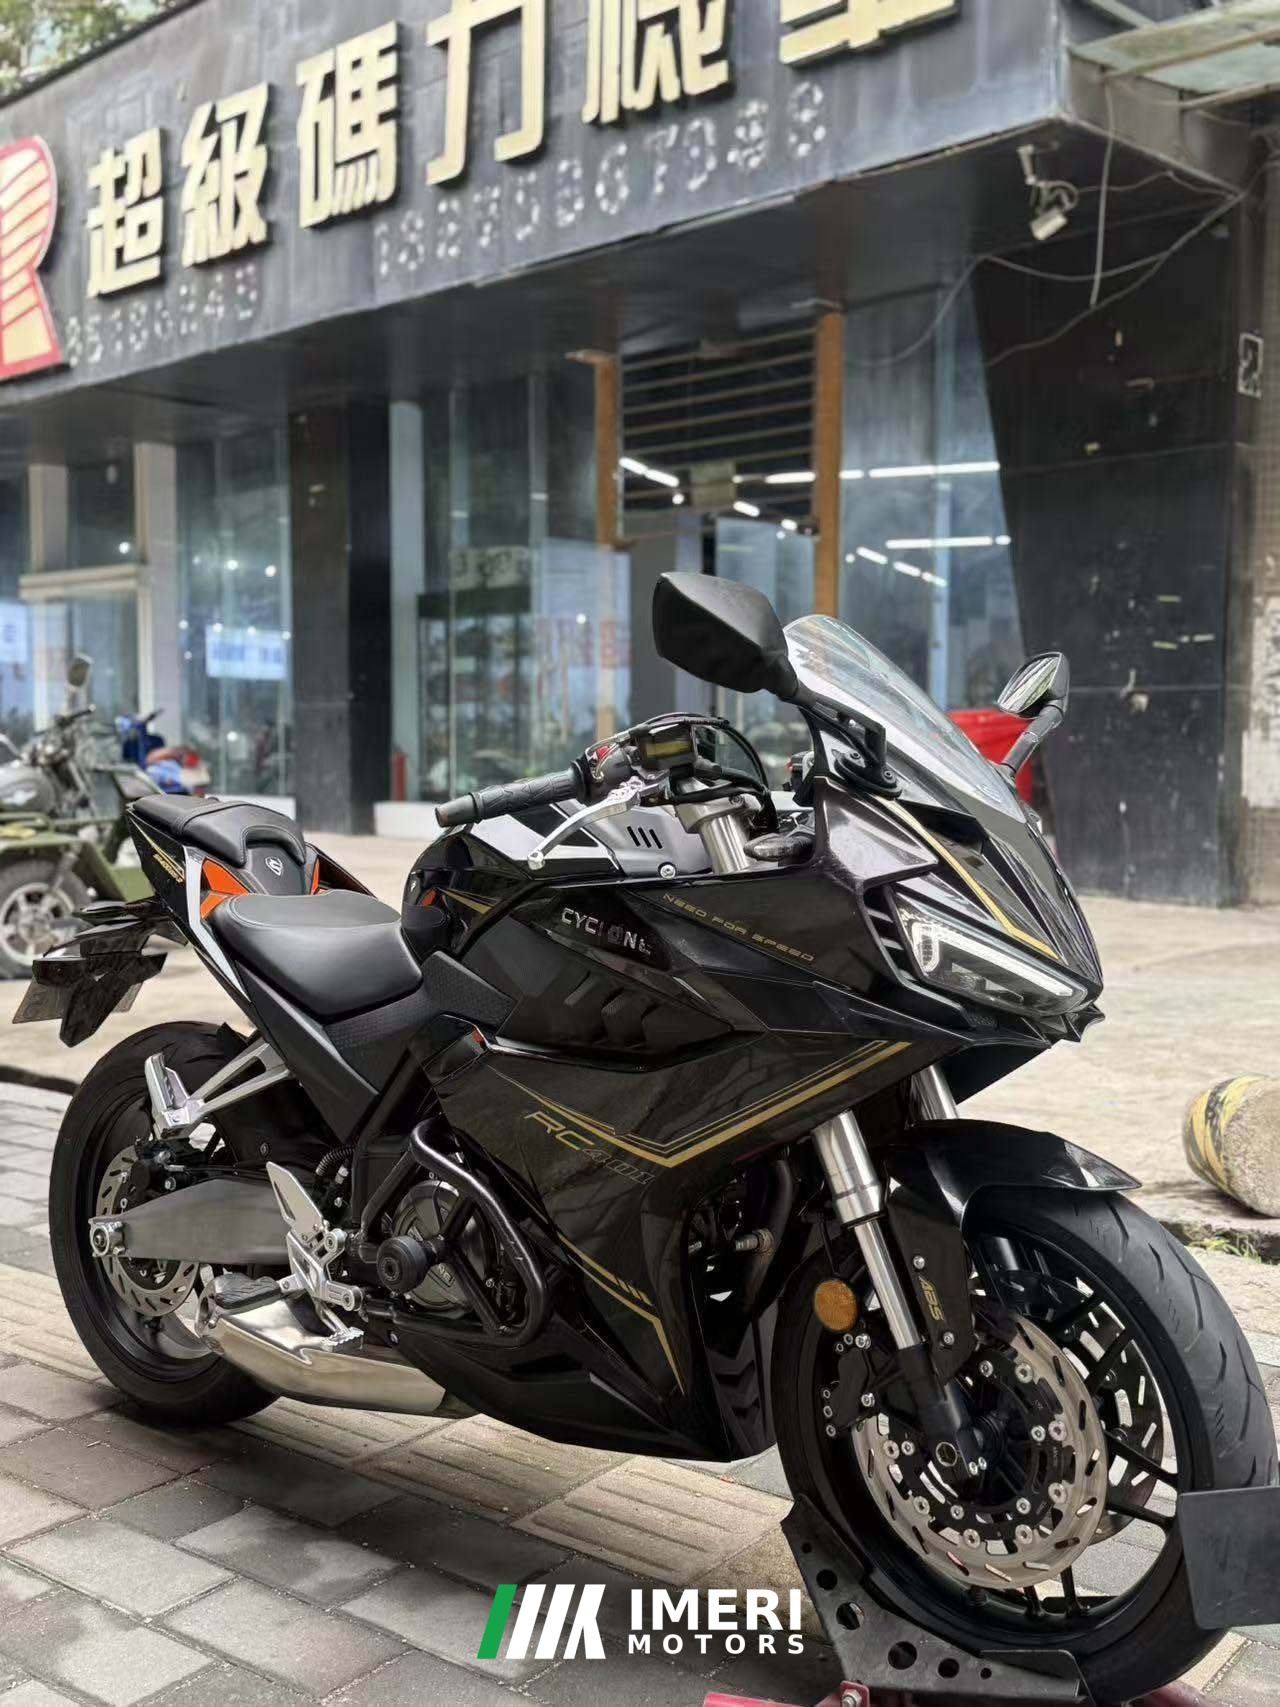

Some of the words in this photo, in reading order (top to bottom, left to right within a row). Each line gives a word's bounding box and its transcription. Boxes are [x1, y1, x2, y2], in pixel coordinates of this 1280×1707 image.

[662, 892, 708, 918] NEED
[711, 915, 748, 936] FOR
[751, 933, 815, 962] SPEED
[918, 1275, 945, 1321] ABS
